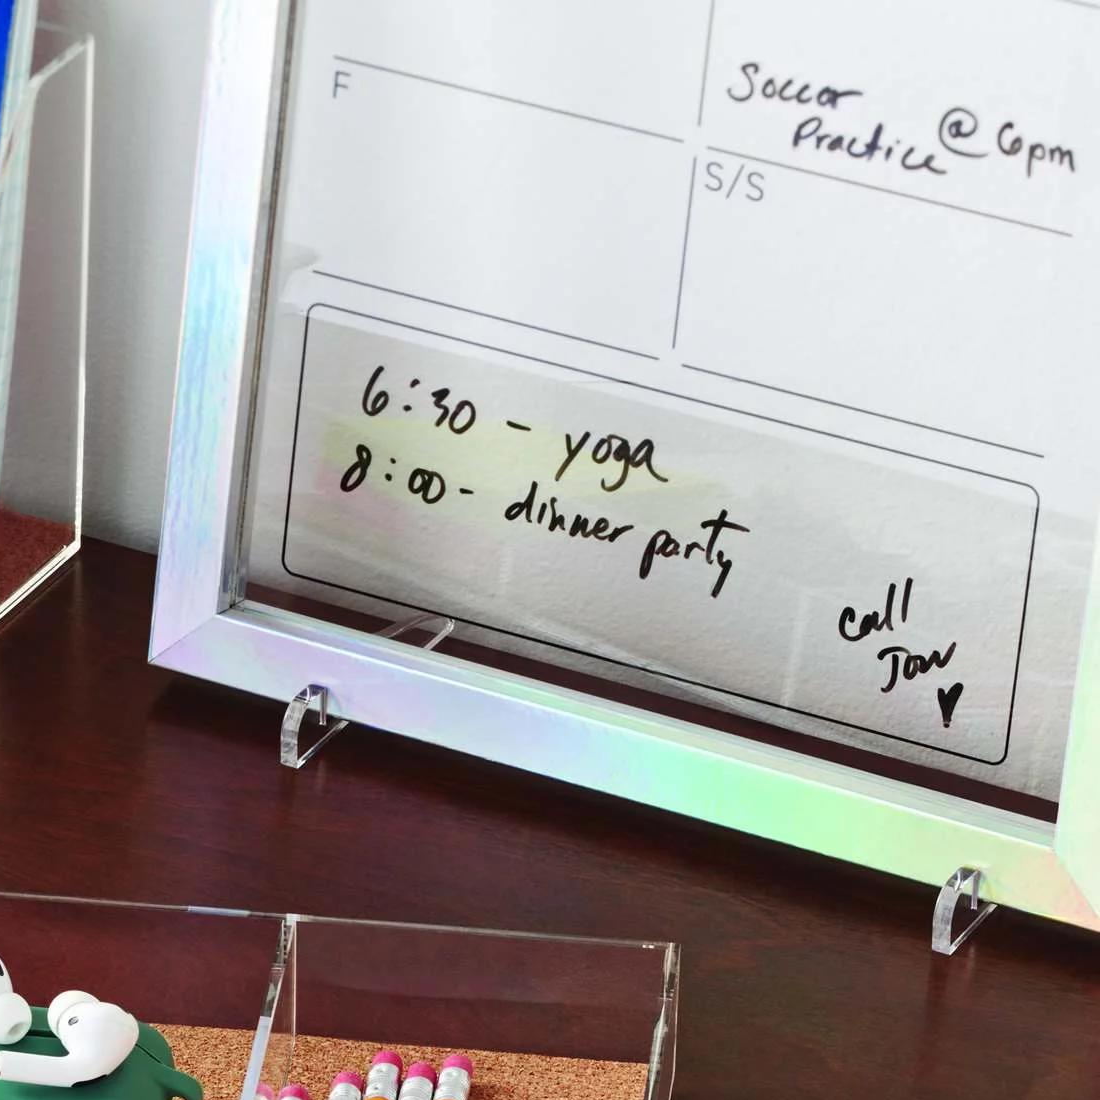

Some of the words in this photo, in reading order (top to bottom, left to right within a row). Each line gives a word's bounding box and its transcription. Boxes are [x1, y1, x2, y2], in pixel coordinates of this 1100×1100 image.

[333, 71, 351, 99] F
[792, 116, 948, 175] Practice
[939, 107, 989, 158] @
[996, 121, 1075, 178] 6pm
[704, 161, 765, 202] S/S
[362, 365, 477, 435] 6:30
[554, 431, 669, 492] yoga
[504, 480, 635, 543] dinner
[639, 509, 750, 599] party
[838, 577, 913, 642] call
